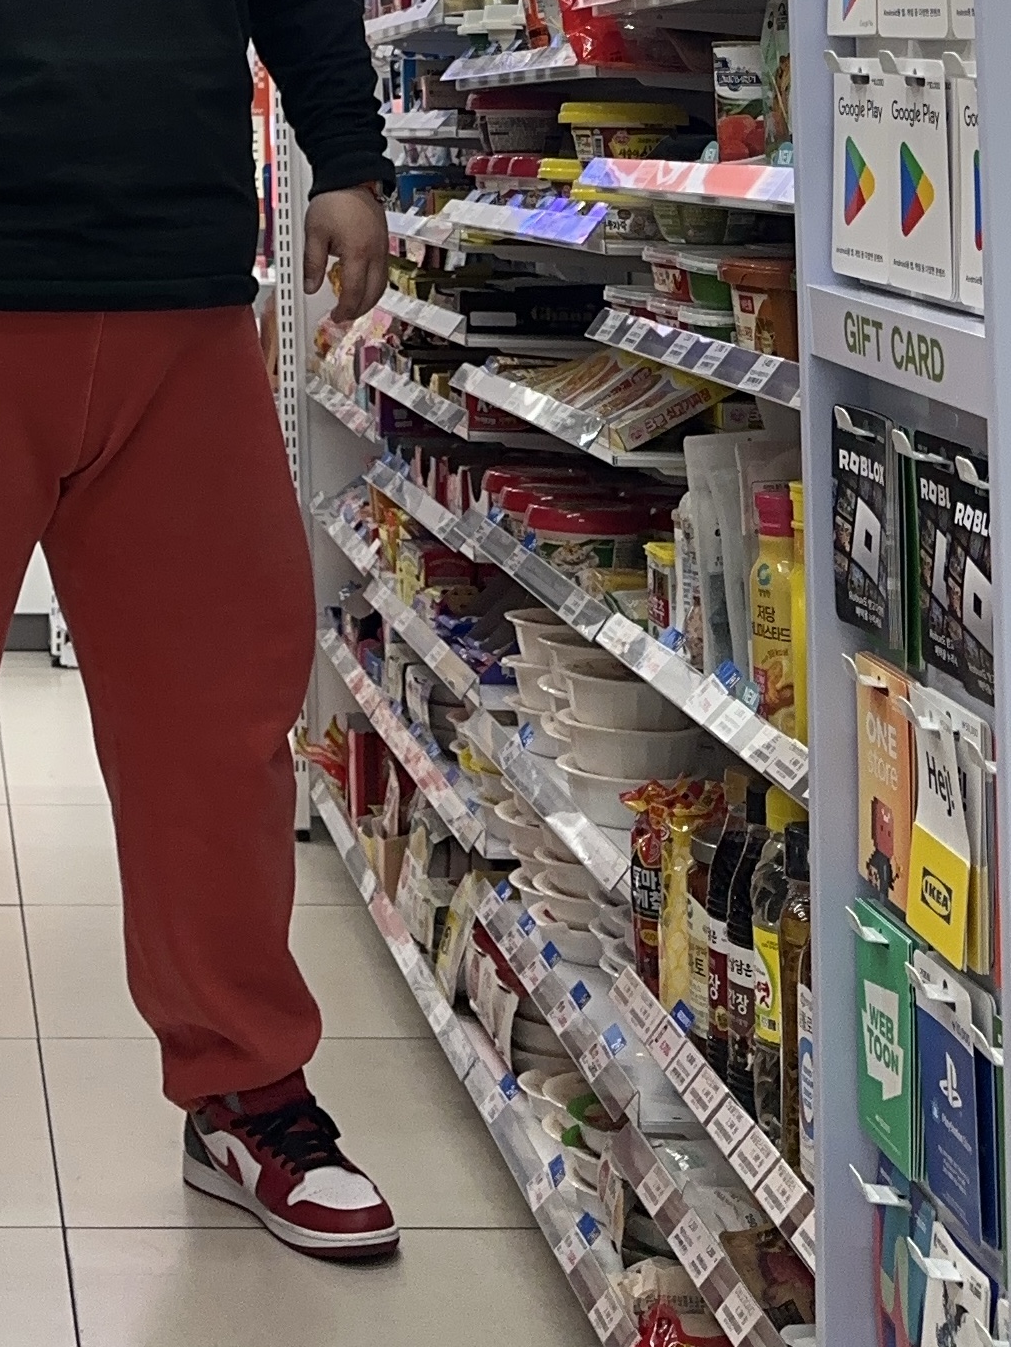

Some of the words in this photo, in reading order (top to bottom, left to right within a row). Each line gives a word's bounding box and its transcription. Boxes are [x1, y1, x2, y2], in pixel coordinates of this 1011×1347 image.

[838, 96, 865, 122] Google
[866, 99, 883, 124] Play
[891, 100, 921, 127] Google
[922, 103, 940, 130] Play
[844, 310, 884, 363] GIFT
[891, 325, 945, 384] CARD
[839, 449, 885, 487] ROBLOX
[919, 477, 951, 510] ROBL
[954, 501, 991, 538] ROBL
[757, 604, 776, 623] 저당
[865, 710, 898, 761] ONE
[867, 750, 899, 792] store
[924, 749, 955, 818] Hej!
[924, 876, 951, 913] IKEA
[868, 1002, 895, 1041] WEB
[866, 1026, 900, 1076] TOON
